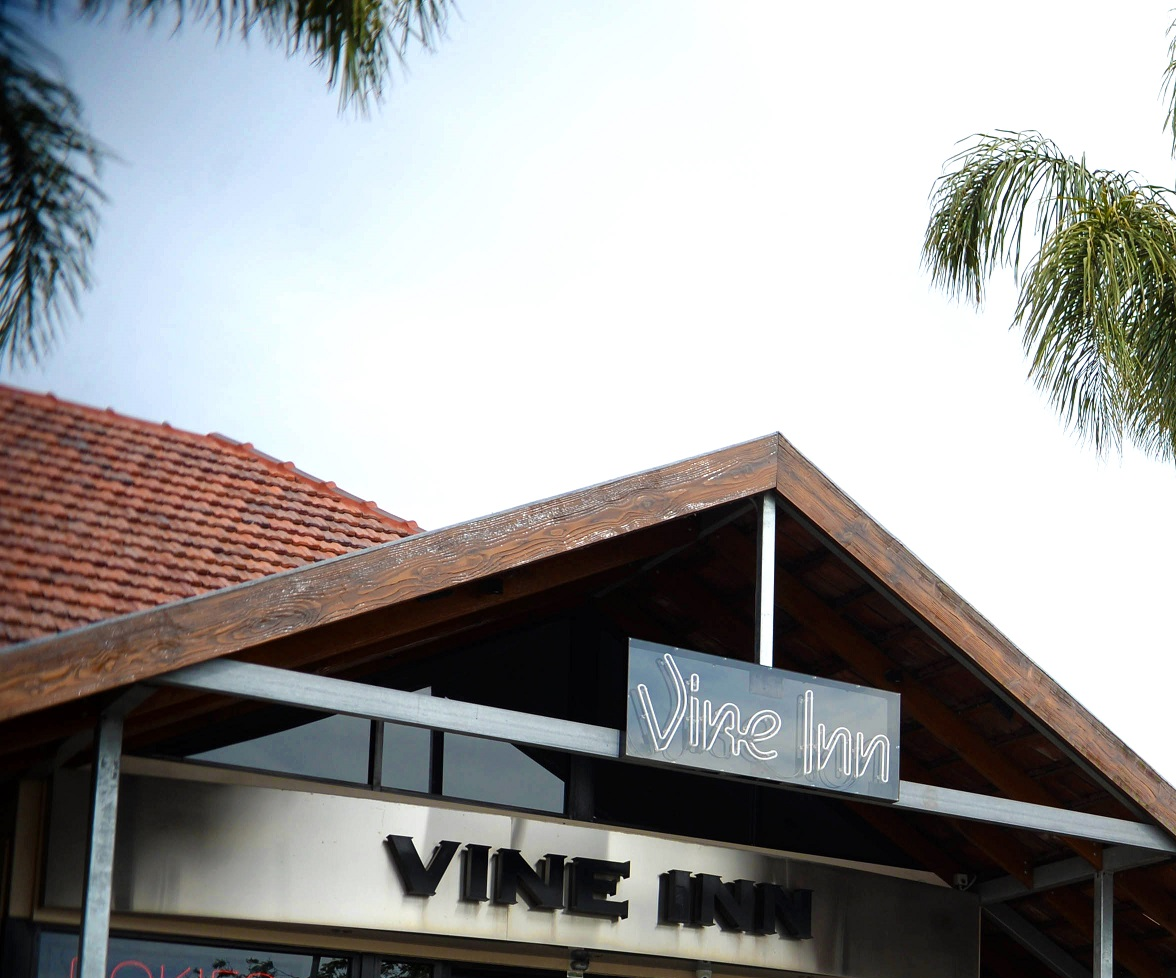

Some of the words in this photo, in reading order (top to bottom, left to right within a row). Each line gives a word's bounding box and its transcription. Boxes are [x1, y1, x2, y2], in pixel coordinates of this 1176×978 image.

[637, 653, 782, 761] Vine
[803, 689, 890, 783] Inn
[383, 834, 631, 920] VINE
[658, 868, 814, 940] INN
